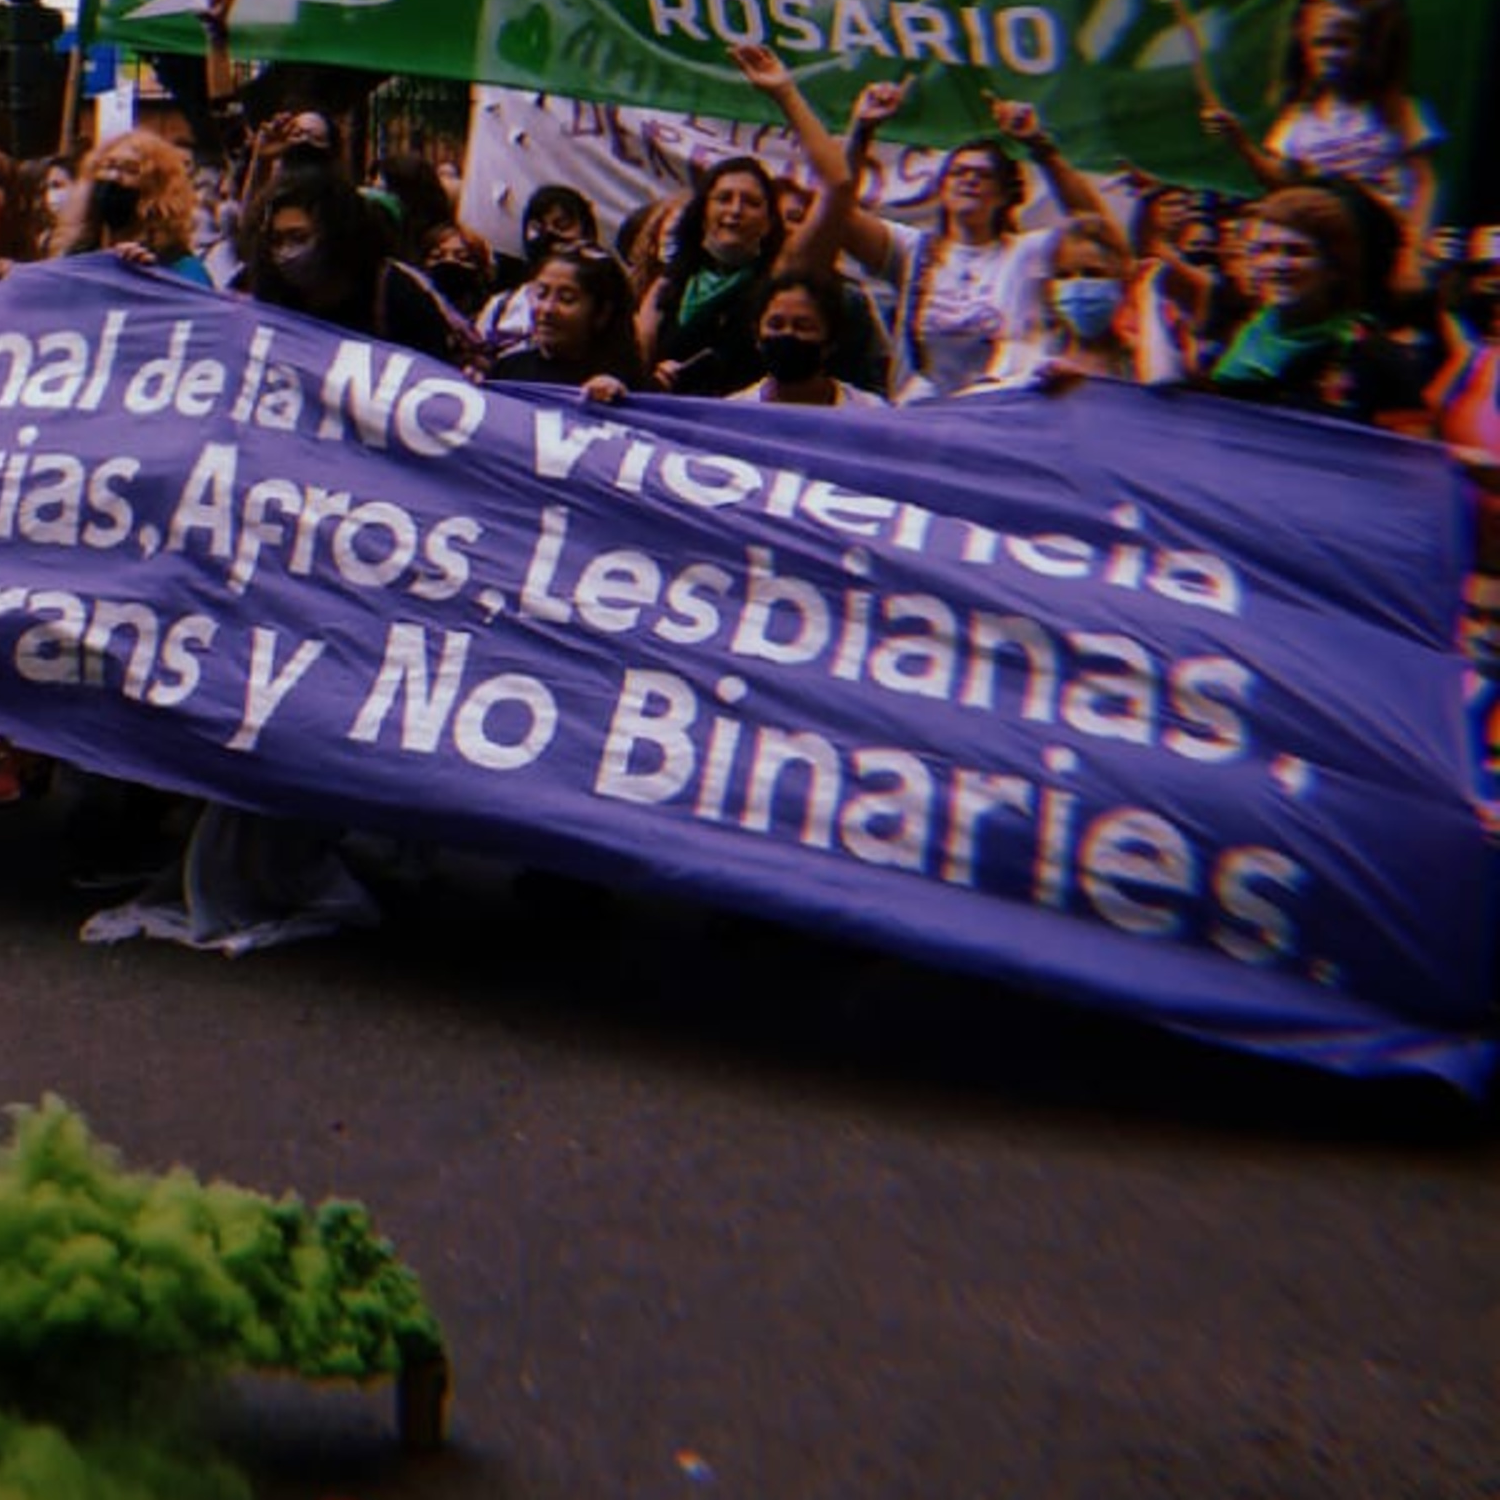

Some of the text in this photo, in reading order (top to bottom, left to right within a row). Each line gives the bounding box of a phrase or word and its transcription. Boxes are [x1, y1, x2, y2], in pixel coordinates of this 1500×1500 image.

[124, 319, 227, 417] de
[230, 325, 300, 432] la
[224, 626, 326, 752] y
[346, 620, 559, 771] No
